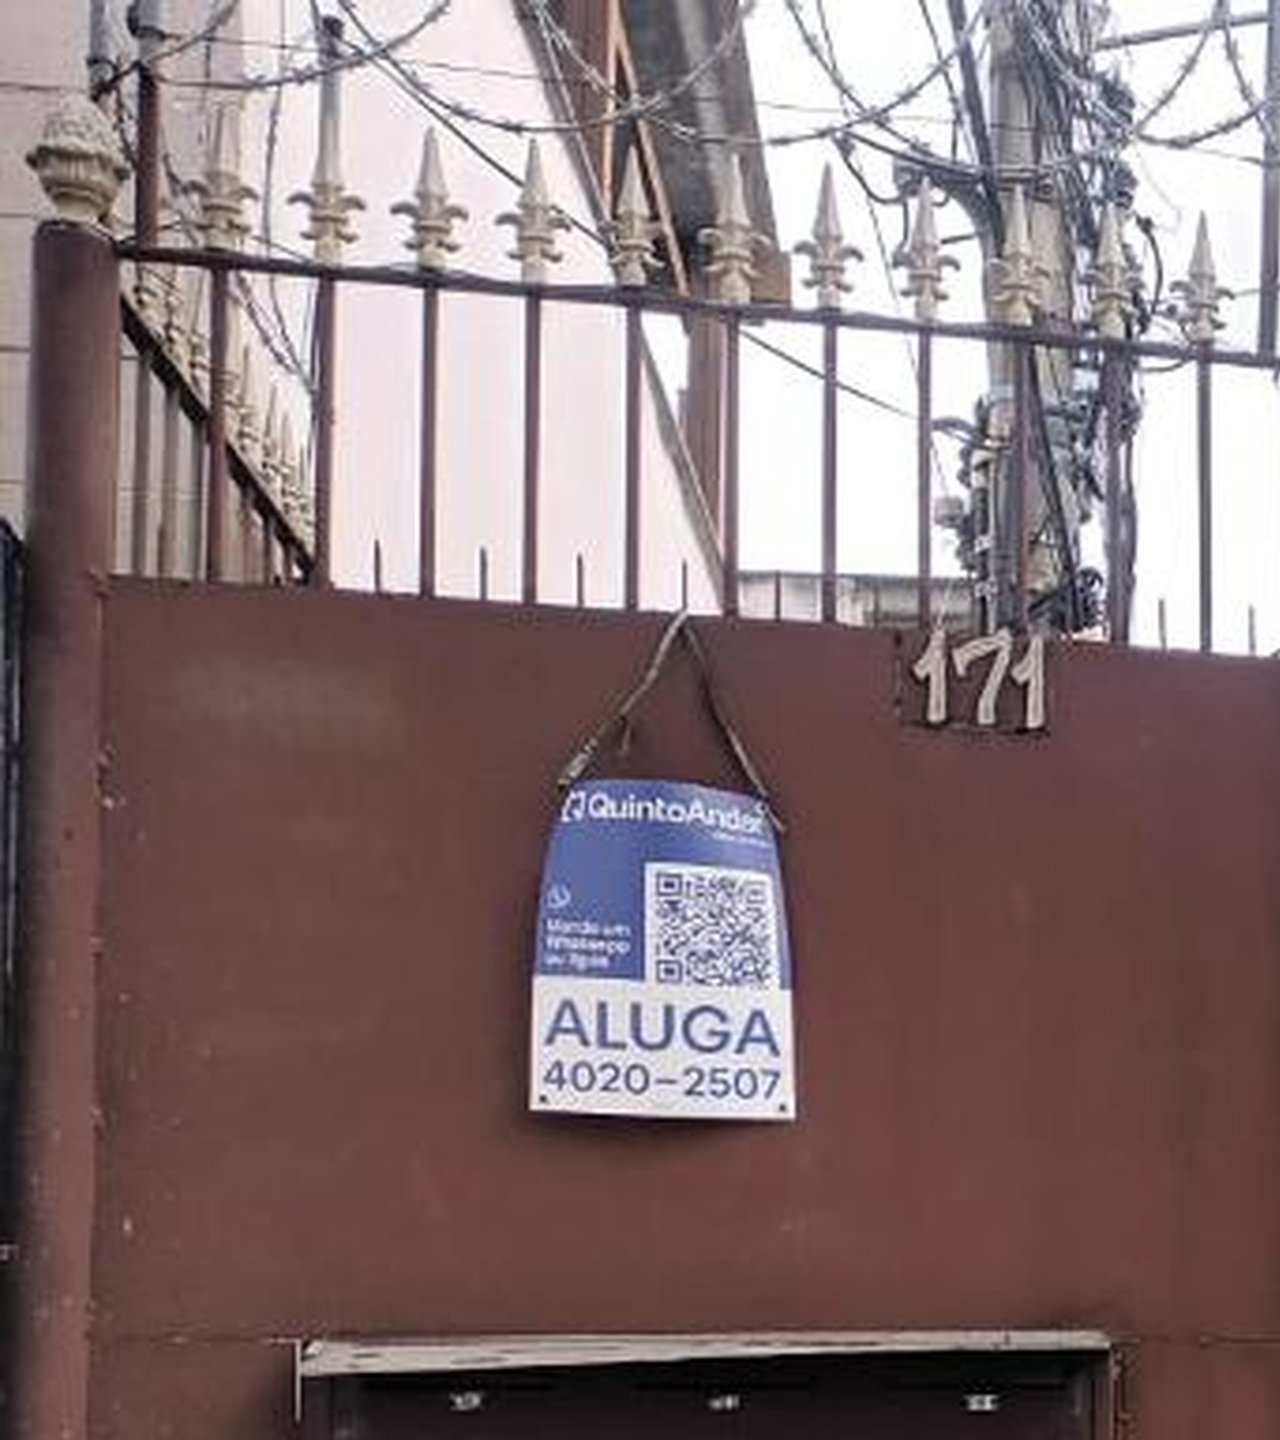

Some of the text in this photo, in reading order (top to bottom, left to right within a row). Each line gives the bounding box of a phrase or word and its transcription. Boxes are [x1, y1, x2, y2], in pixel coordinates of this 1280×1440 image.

[913, 627, 1045, 729] 171
[545, 999, 781, 1058] ALUGA
[543, 1060, 781, 1100] 4020-2507
